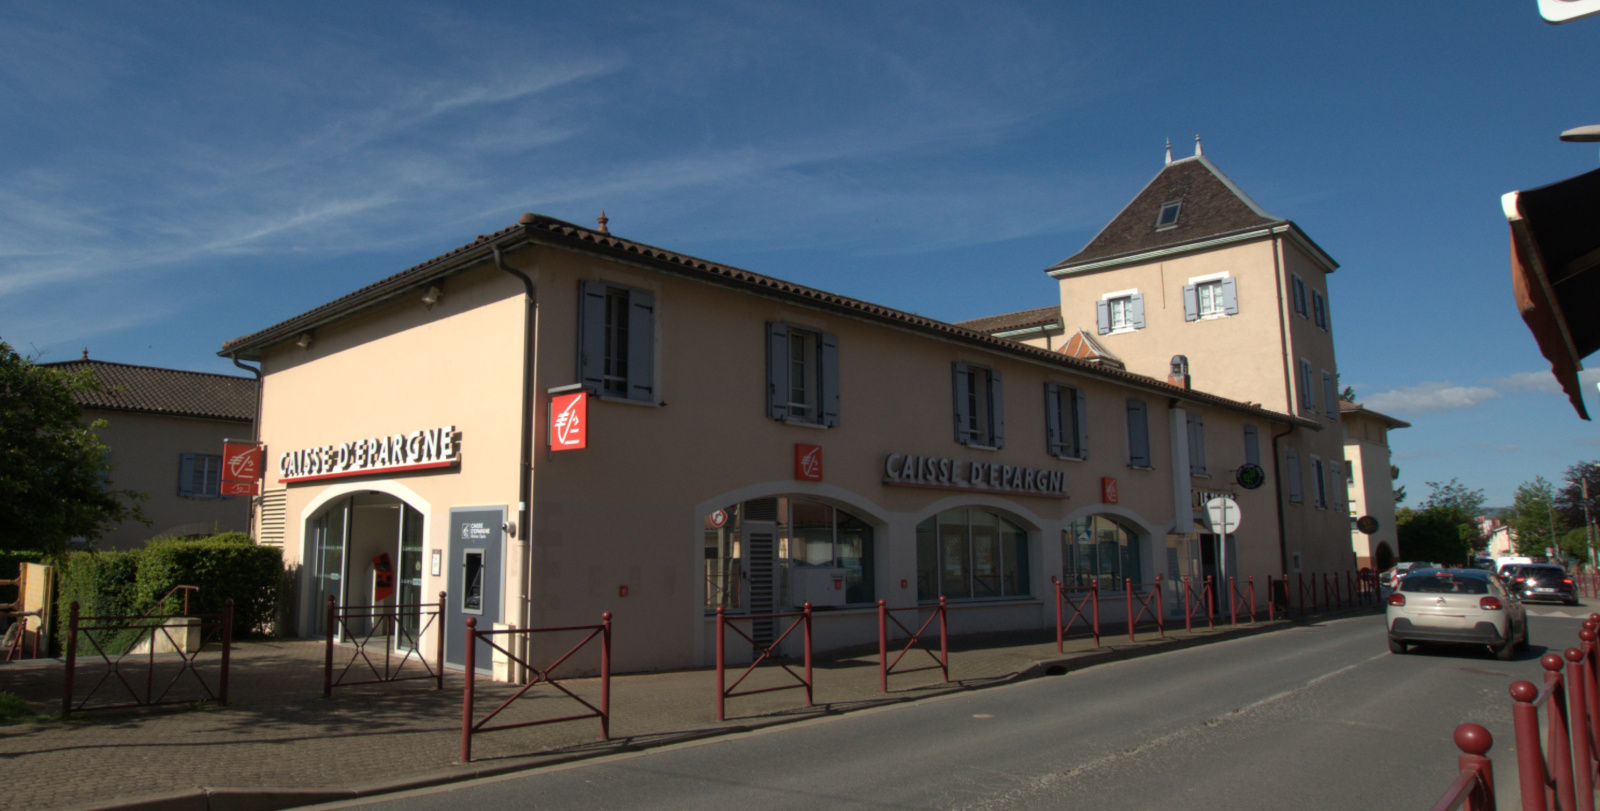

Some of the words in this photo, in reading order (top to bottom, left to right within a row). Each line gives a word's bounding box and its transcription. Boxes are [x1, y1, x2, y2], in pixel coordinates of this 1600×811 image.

[279, 446, 334, 476] CAISSE
[338, 425, 456, 470] D'EPARGNE
[885, 452, 964, 483] CAISSE
